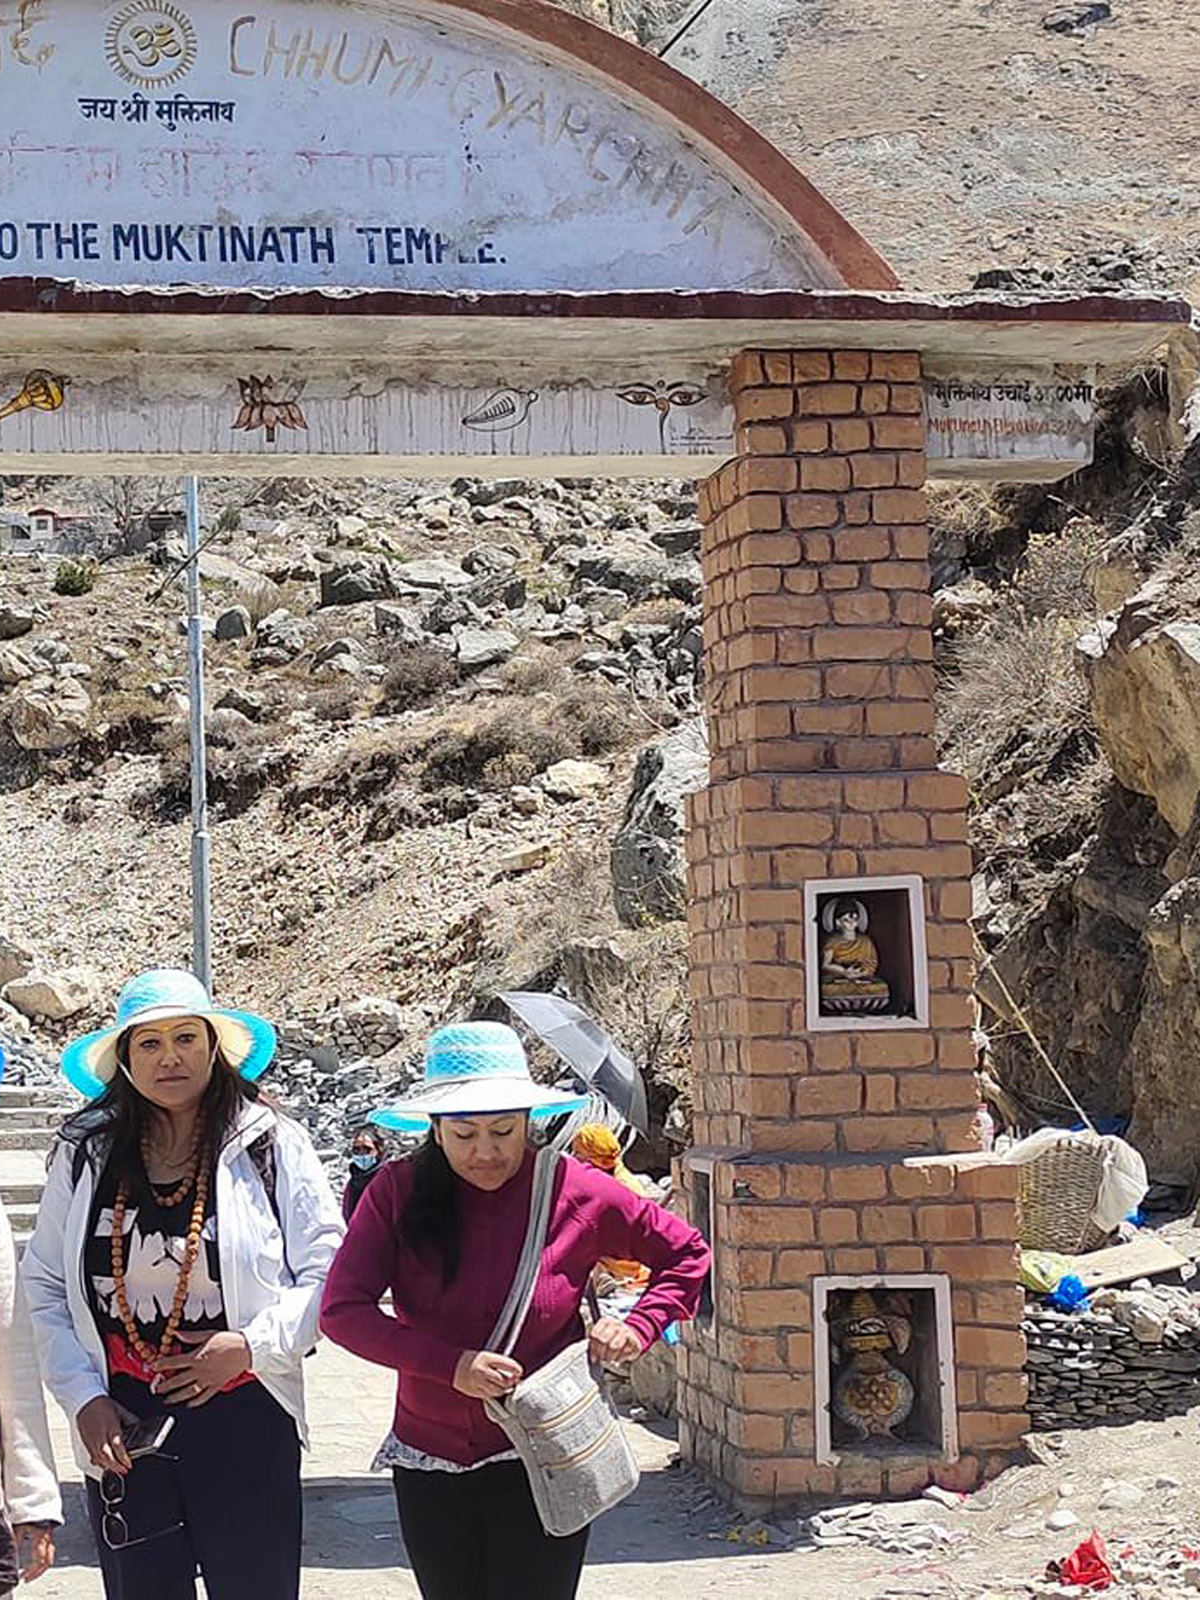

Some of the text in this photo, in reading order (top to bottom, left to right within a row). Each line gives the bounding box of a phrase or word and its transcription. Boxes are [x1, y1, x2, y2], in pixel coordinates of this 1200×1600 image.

[78, 92, 236, 132] जय श्री मुक्तिनाथ
[26, 222, 101, 261] THE
[112, 223, 336, 265] MUKTINATH
